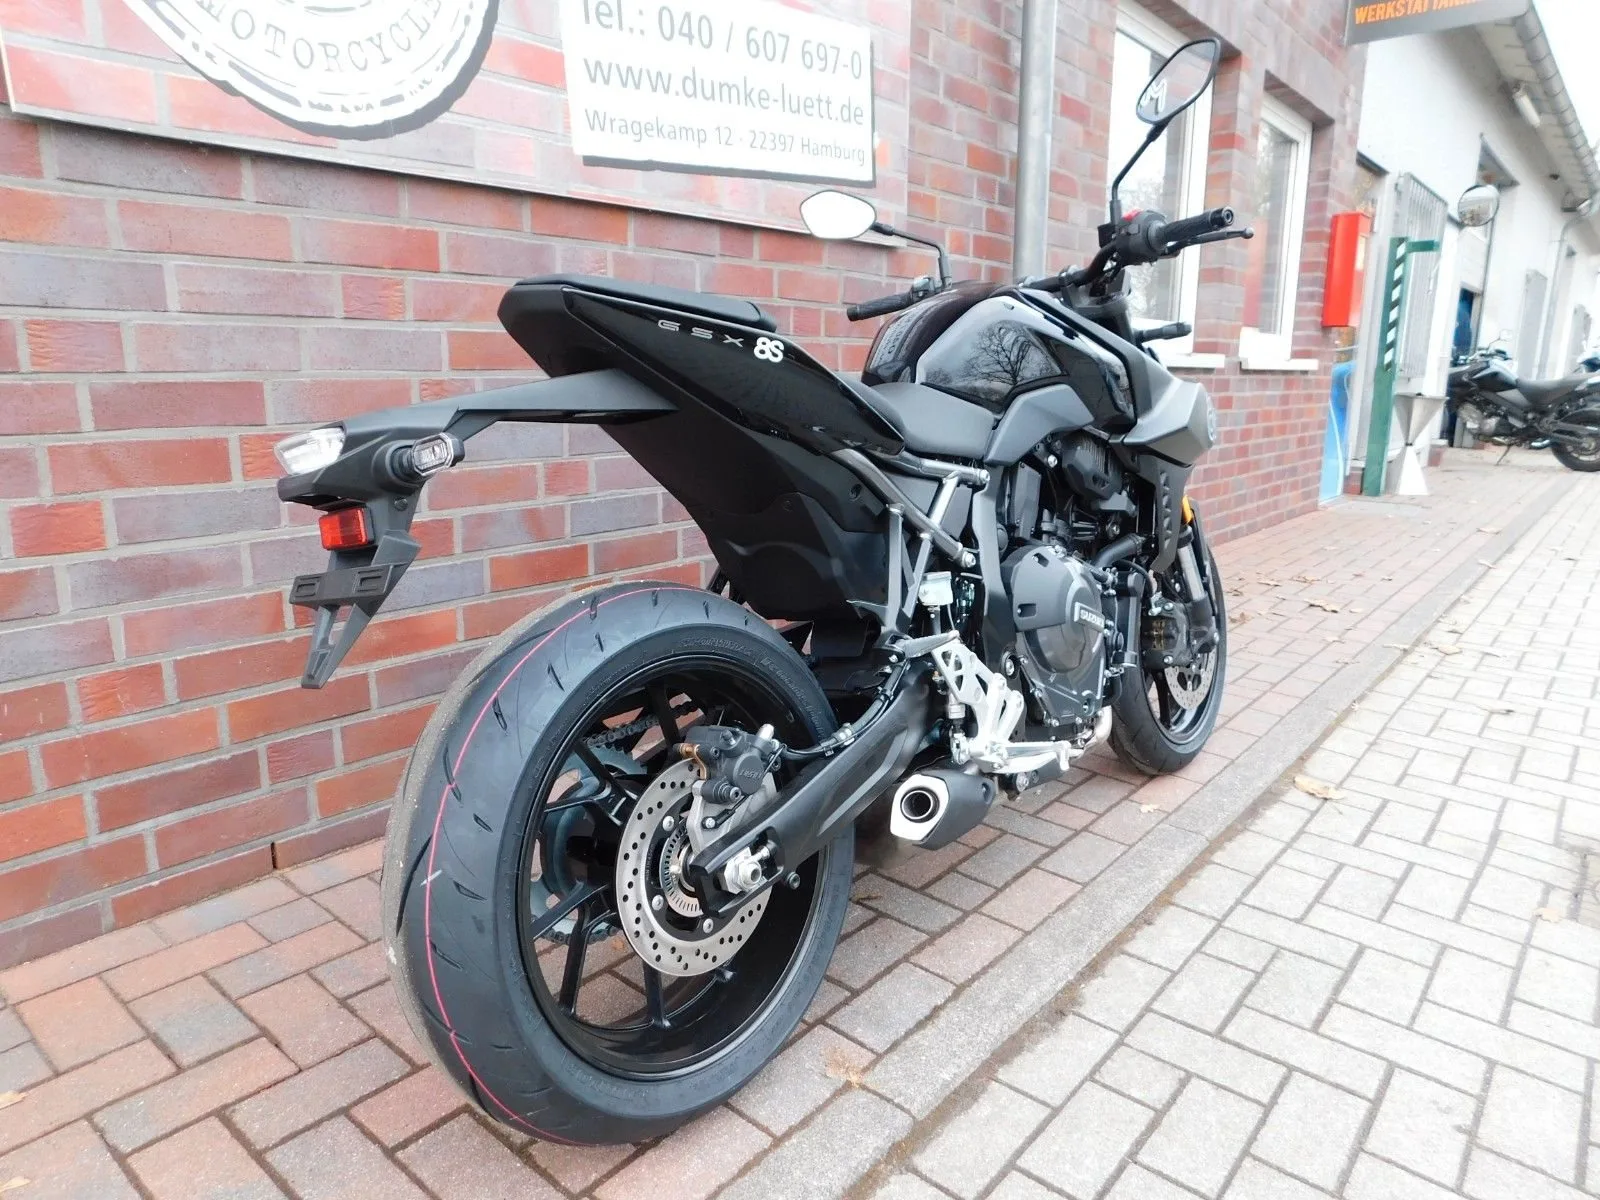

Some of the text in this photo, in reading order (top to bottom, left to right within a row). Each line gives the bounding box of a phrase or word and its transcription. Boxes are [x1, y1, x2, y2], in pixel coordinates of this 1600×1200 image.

[657, 5, 714, 50] 040
[745, 26, 790, 64] 607
[801, 39, 862, 80] 697-0
[583, 57, 864, 126] www.dumke-luett.de
[585, 108, 707, 149] Wragekamp
[715, 125, 734, 147] 12
[749, 129, 794, 153] 22397
[801, 137, 865, 167] Hamburg
[753, 336, 785, 363] 8S
